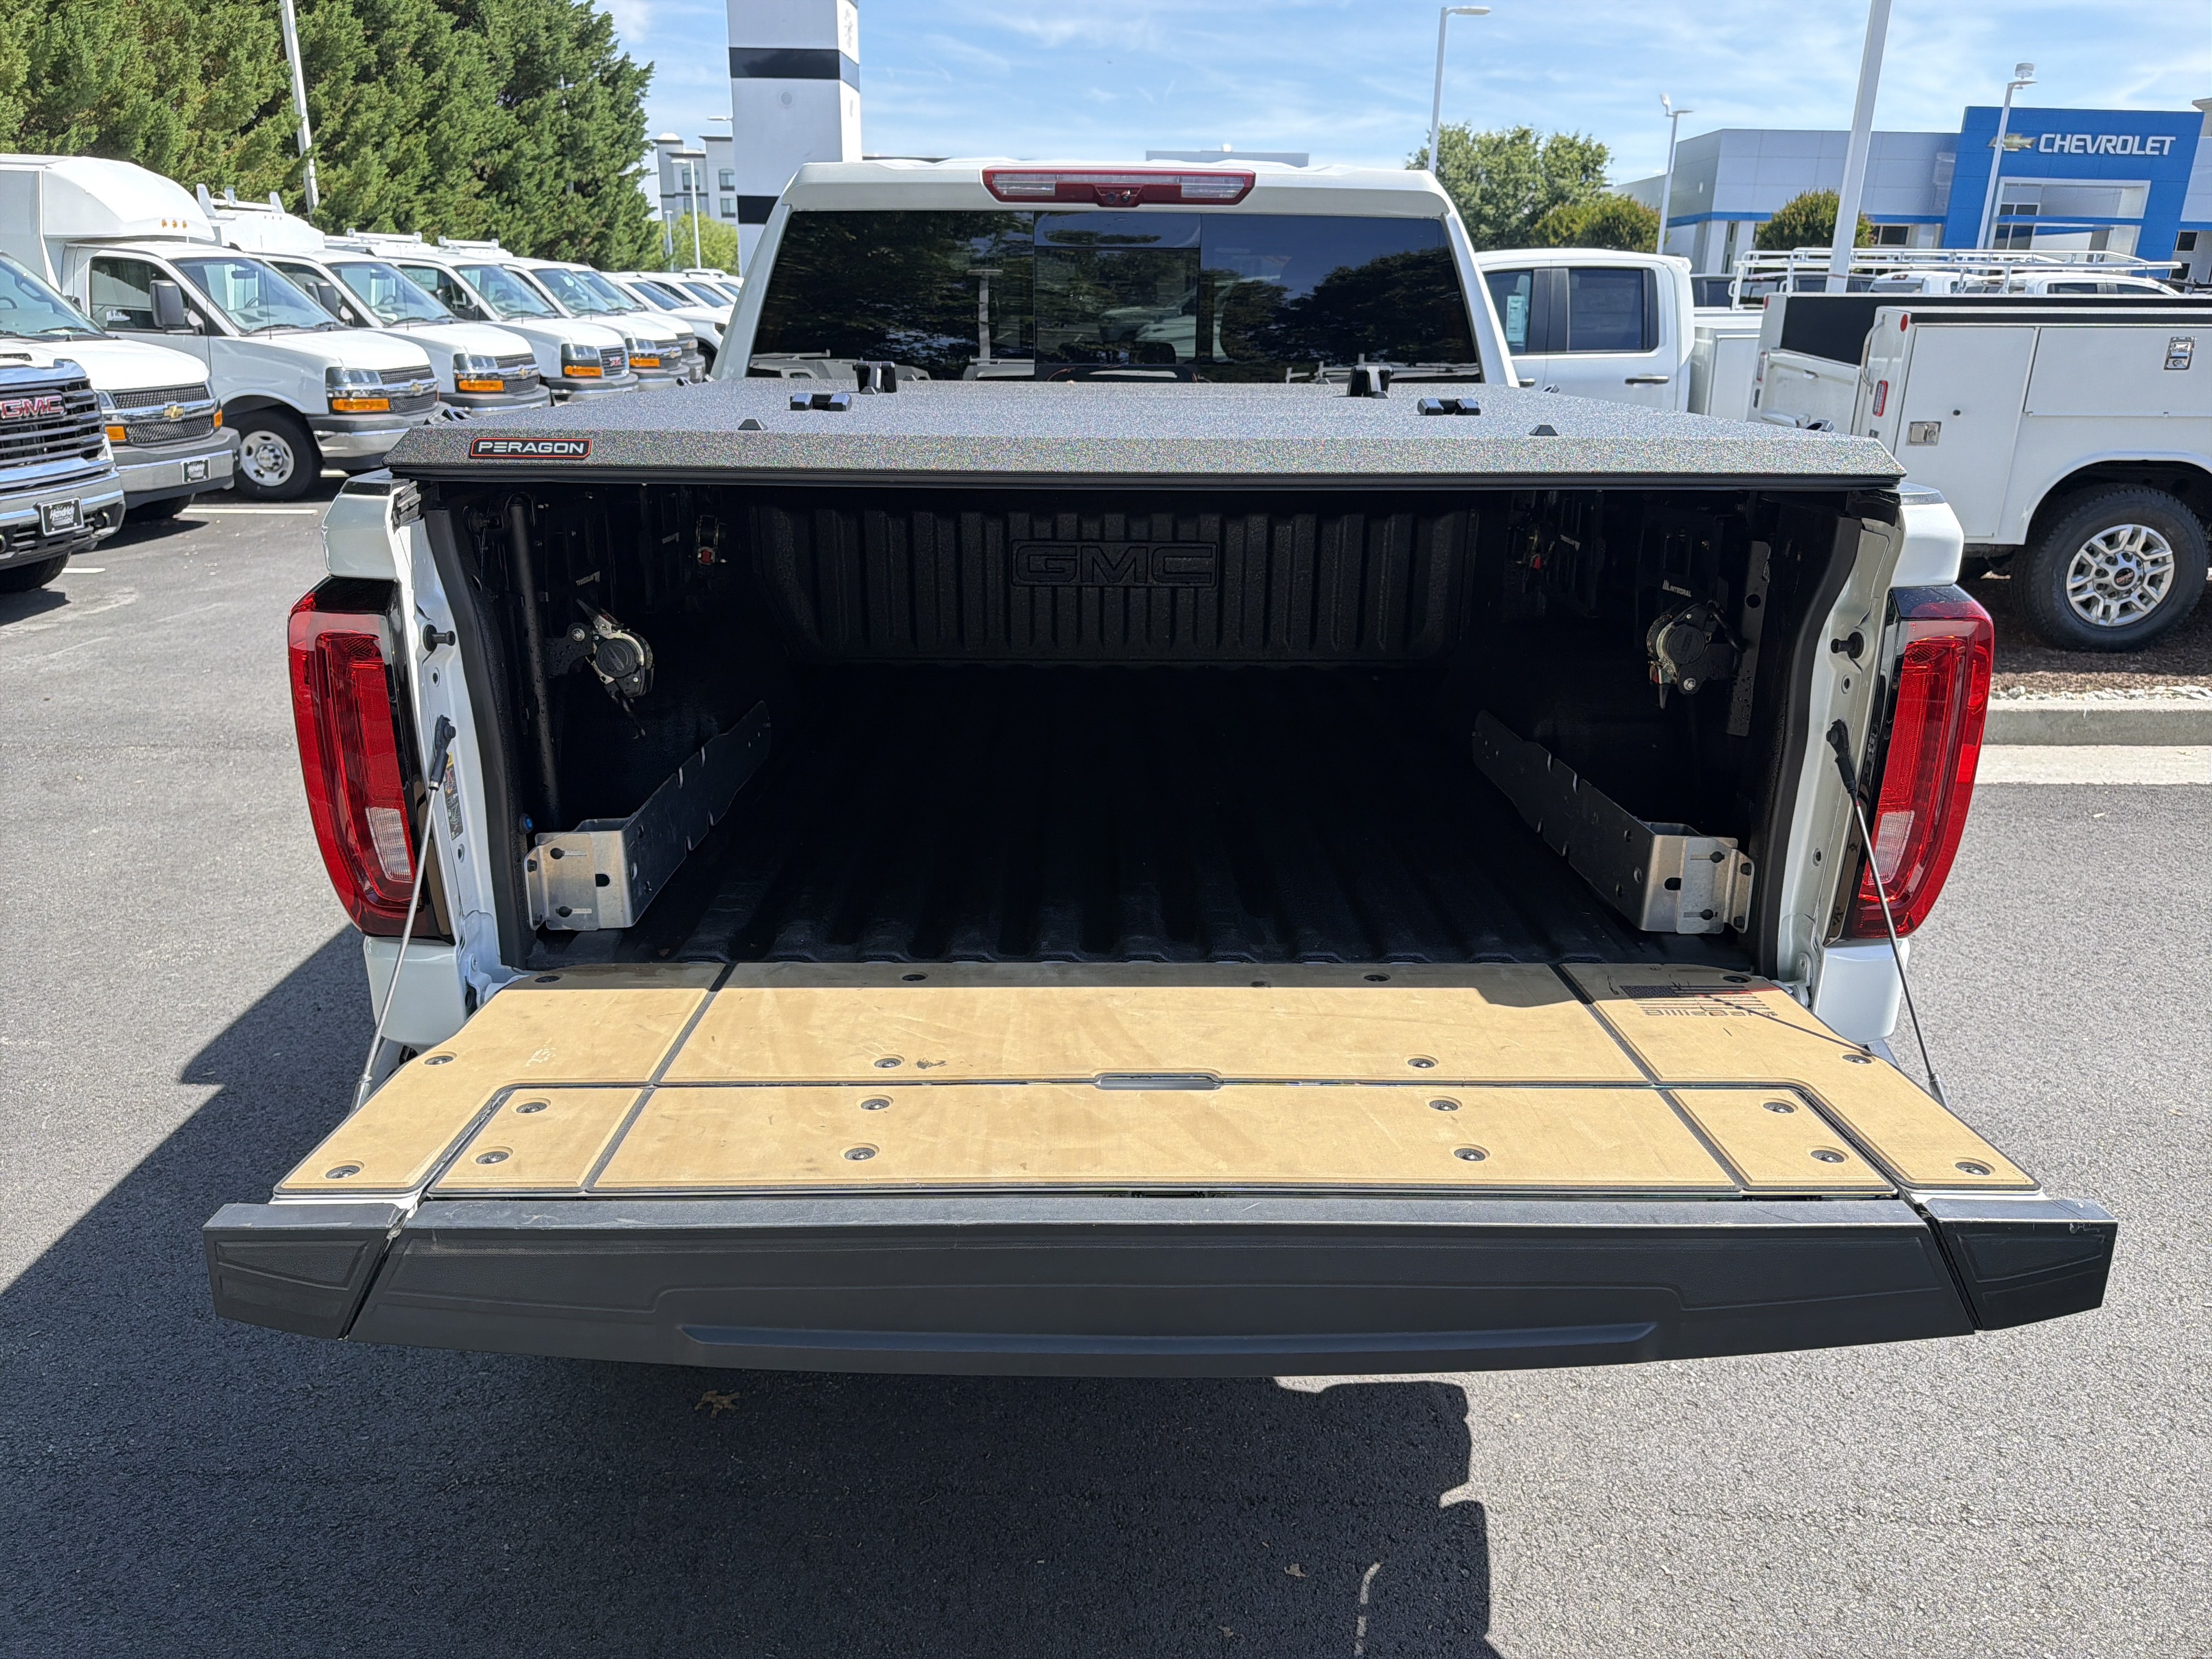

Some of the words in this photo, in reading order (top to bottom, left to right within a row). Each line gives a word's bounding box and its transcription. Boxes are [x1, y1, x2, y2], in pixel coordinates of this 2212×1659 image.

[2039, 133, 2176, 155] CHEVROLET
[0, 395, 62, 418] GMC
[478, 441, 584, 454] PERAGON
[1016, 545, 1214, 584] GMC
[1670, 585, 1691, 597] INTEGRAL
